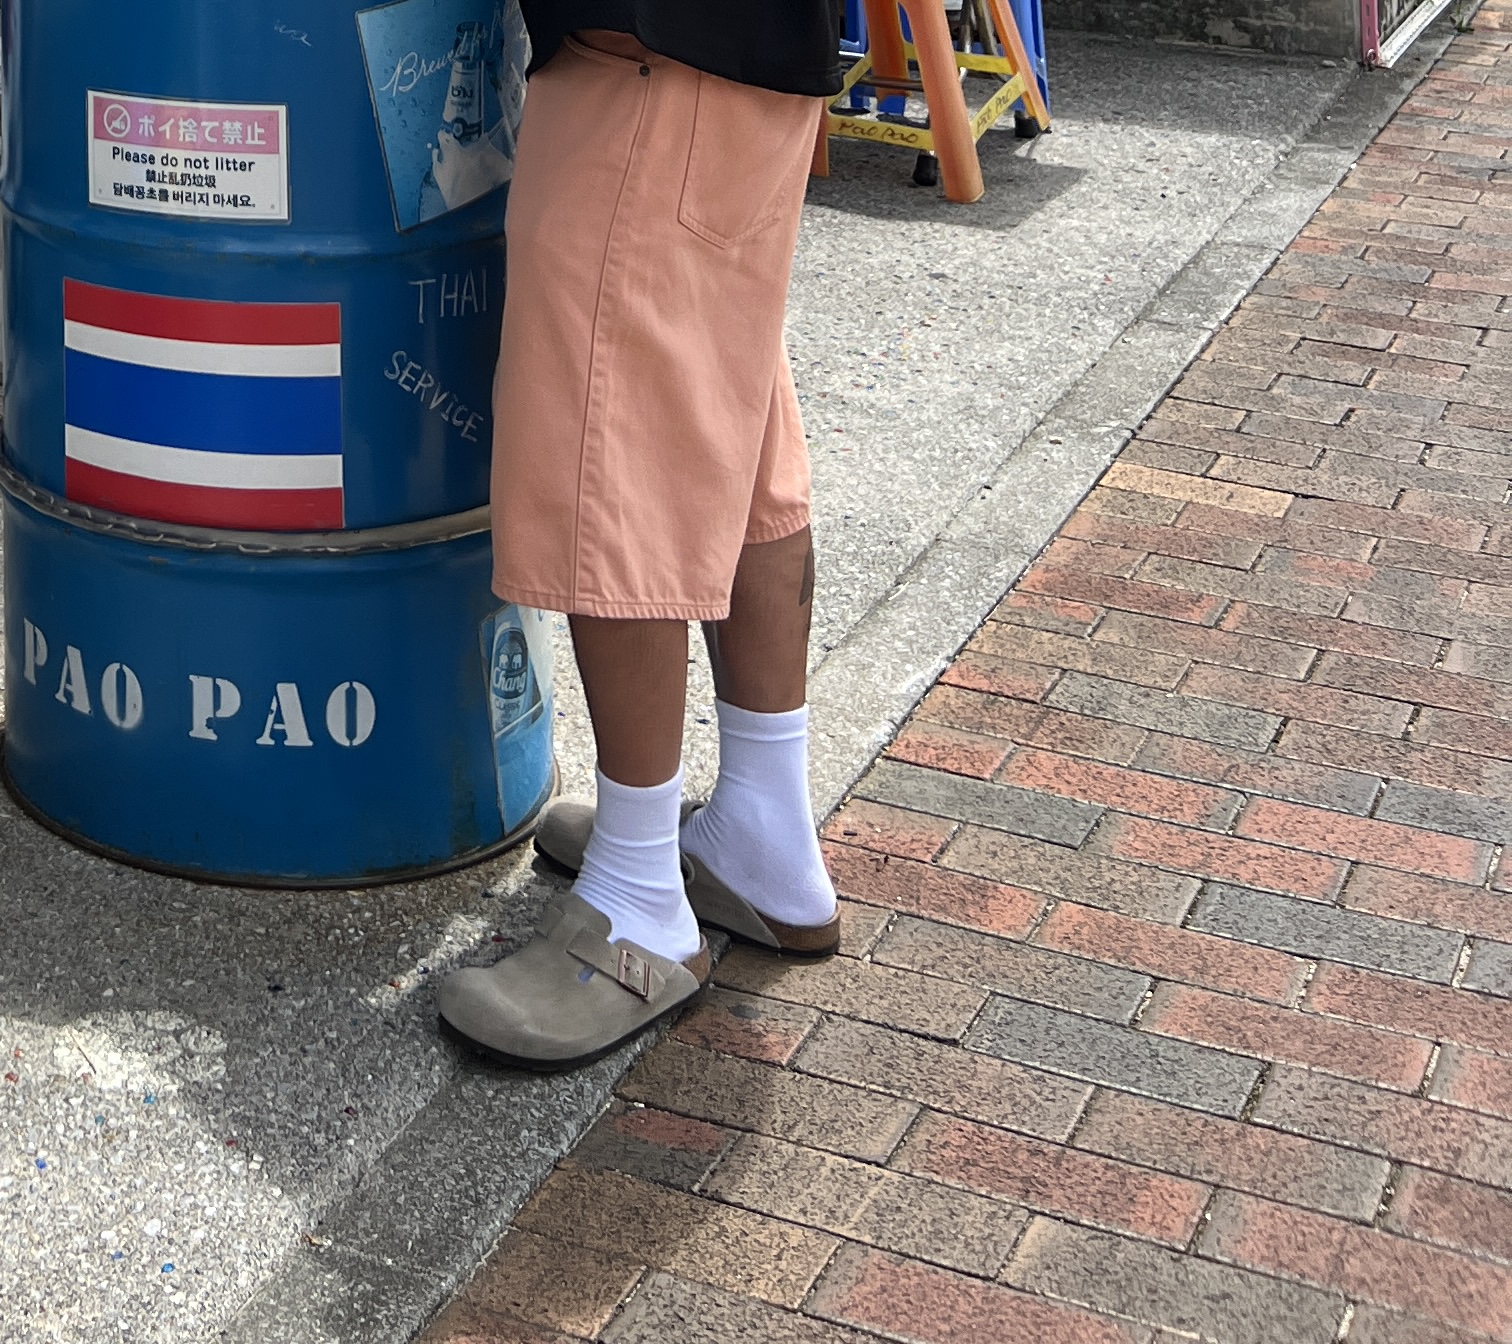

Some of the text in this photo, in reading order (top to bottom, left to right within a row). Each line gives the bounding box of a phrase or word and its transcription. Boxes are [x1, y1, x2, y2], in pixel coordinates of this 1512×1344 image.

[137, 114, 267, 146] ポイ捨て禁止
[112, 146, 256, 173] Please do not litter
[172, 190, 210, 207] 버리지
[407, 267, 487, 324] THAI
[383, 349, 485, 443] SERVICE
[22, 616, 377, 748] PAO PAO
[492, 666, 527, 694] Chang
